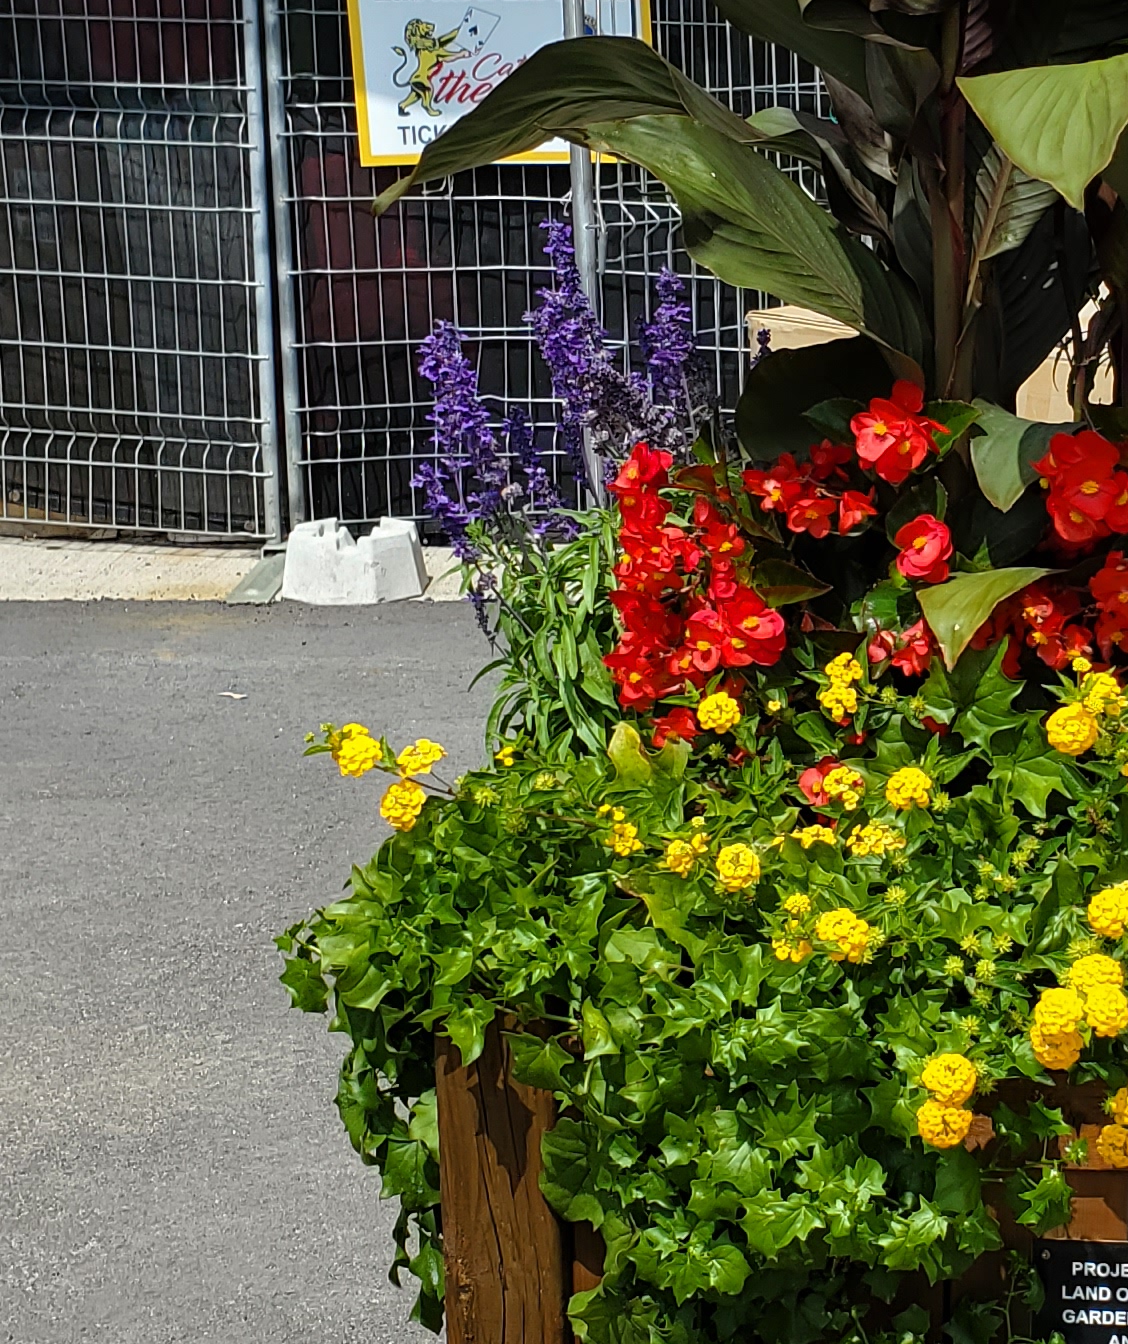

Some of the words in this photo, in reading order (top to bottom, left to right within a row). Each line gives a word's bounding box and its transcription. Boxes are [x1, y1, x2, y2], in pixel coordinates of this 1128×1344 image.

[433, 69, 493, 104] the
[396, 124, 449, 146] TICK
[1061, 1284, 1112, 1302] LAND
